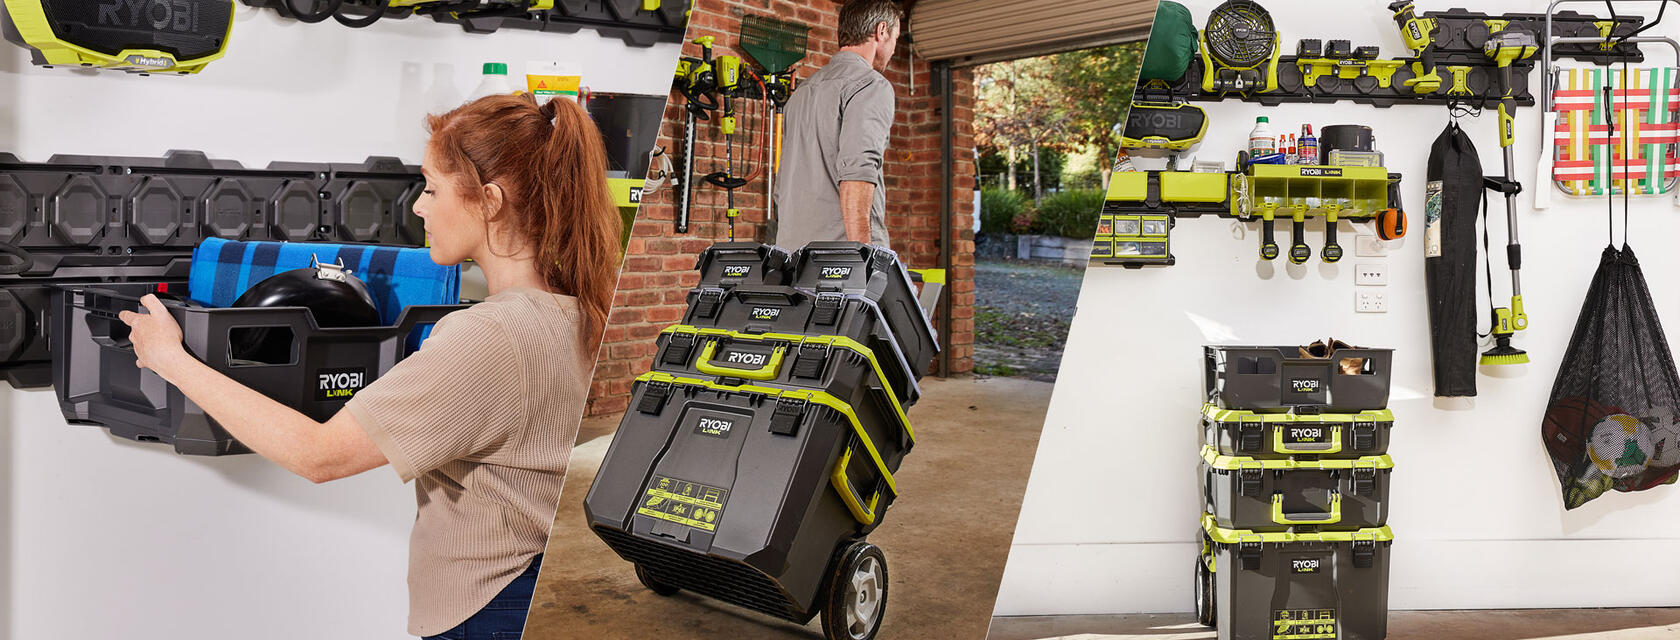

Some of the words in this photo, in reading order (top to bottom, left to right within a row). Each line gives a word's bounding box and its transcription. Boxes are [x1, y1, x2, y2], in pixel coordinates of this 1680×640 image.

[140, 57, 164, 66] Hybrid
[1130, 113, 1182, 129] RYOBI
[724, 265, 750, 274] RYOBI
[821, 267, 851, 275] RYOBI
[752, 307, 780, 317] RYOBI
[727, 351, 767, 366] RYOBI
[319, 372, 364, 390] RYOBI
[1292, 380, 1319, 388] RYOBI
[326, 388, 353, 398] LINK
[699, 418, 732, 432] RYOBI
[702, 428, 722, 436] LINK
[1290, 428, 1322, 438] RYOBI
[1292, 560, 1319, 568] RYOBI
